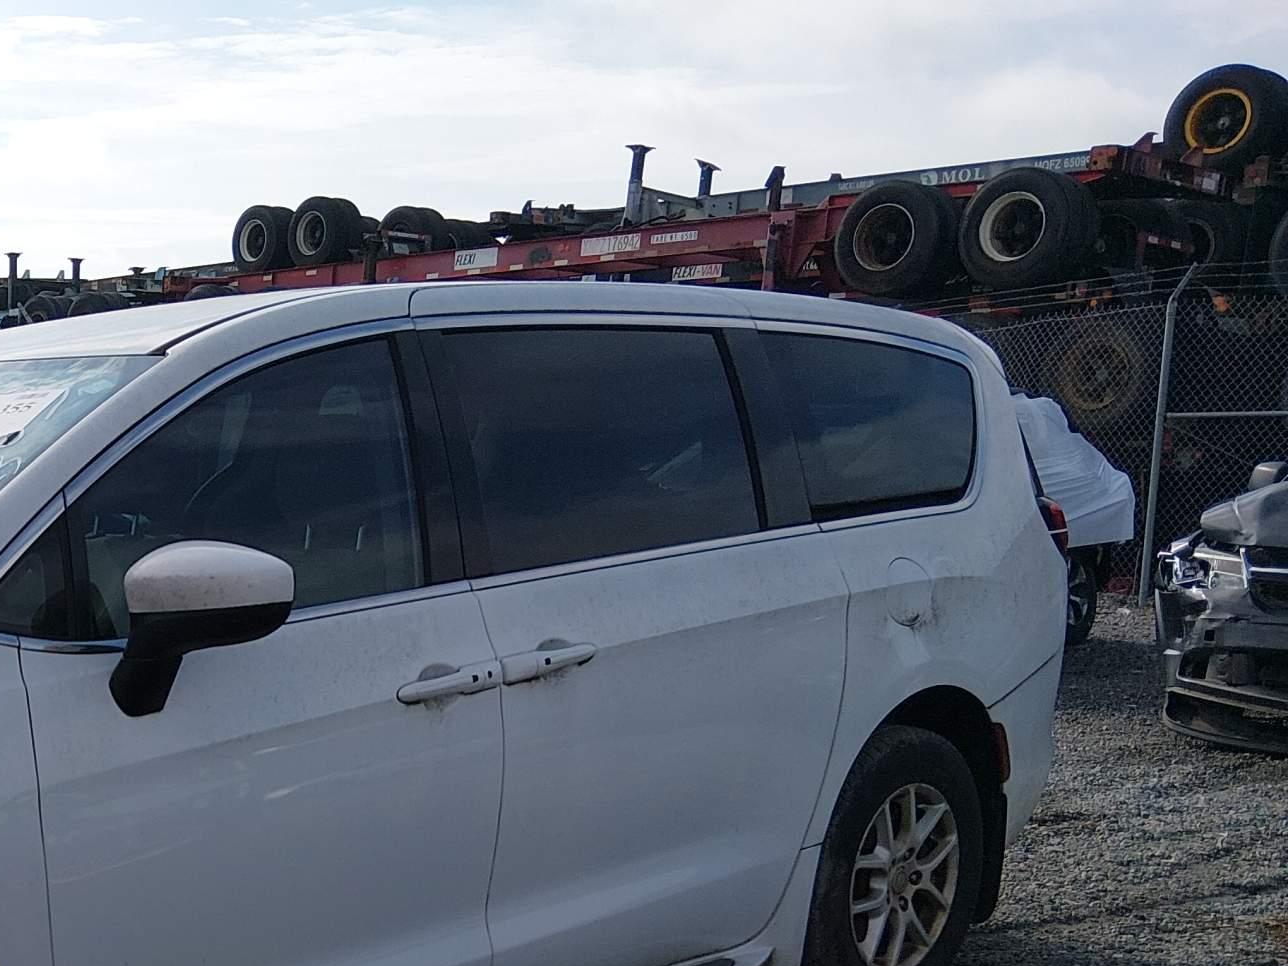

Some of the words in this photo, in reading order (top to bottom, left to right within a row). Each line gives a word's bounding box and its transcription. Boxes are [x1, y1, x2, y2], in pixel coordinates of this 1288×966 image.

[941, 167, 985, 184] MOL
[456, 253, 476, 266] FLEXI
[673, 264, 721, 278] FLEXI-VAN
